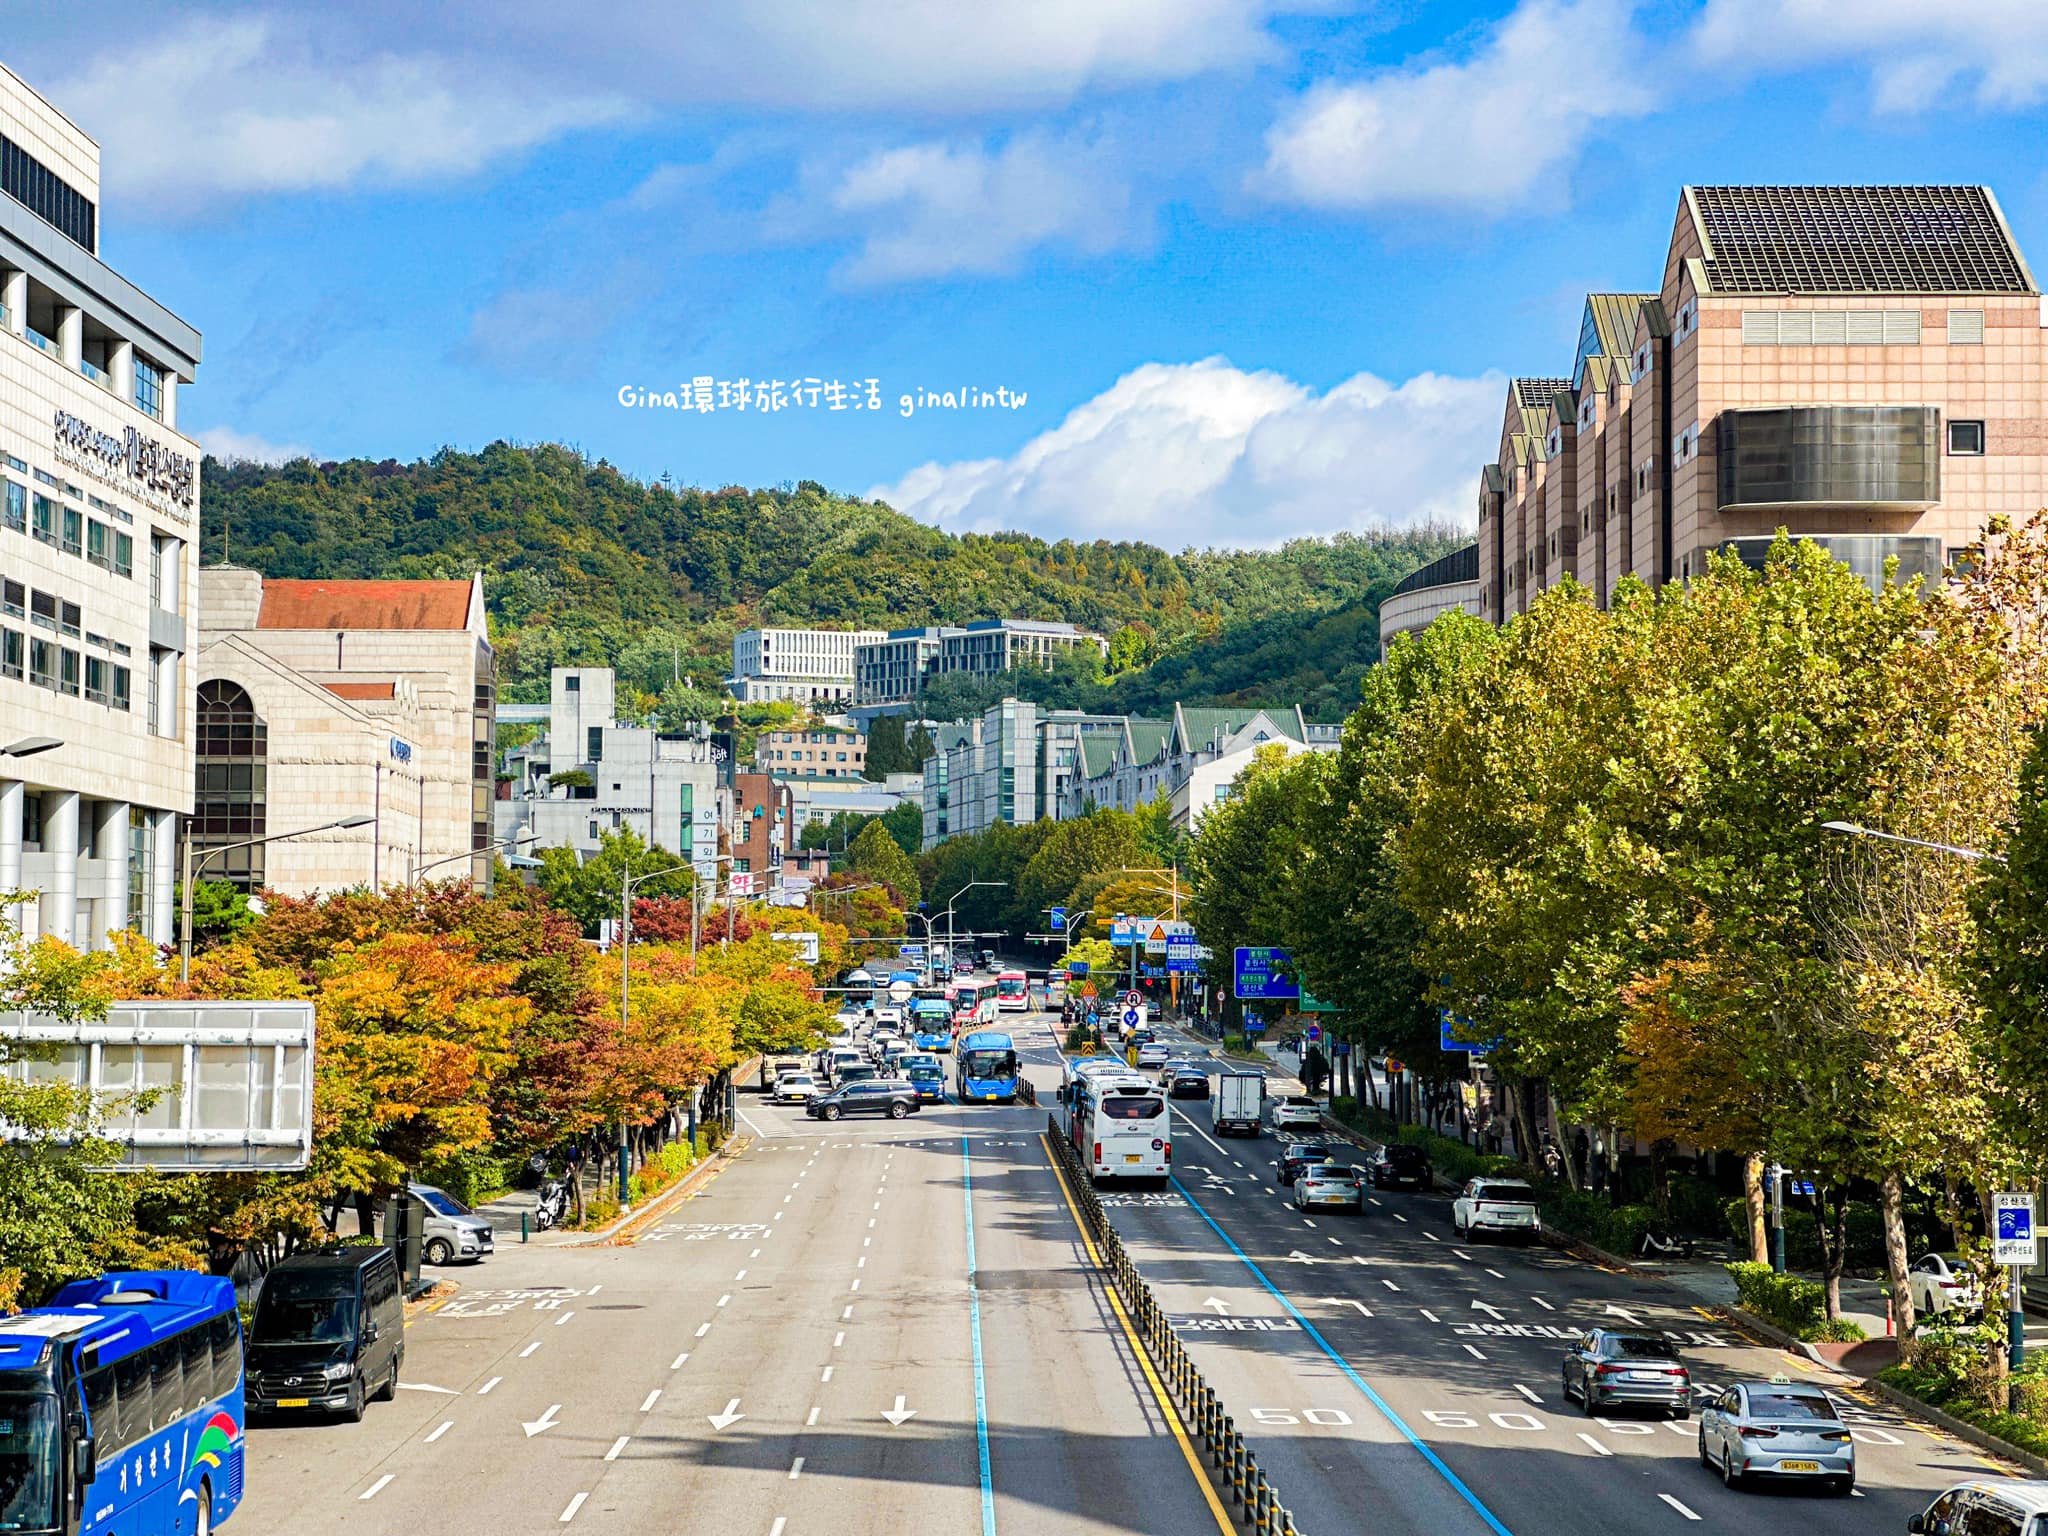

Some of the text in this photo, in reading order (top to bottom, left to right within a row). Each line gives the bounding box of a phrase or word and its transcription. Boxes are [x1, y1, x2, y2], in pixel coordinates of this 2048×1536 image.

[2000, 1197, 2029, 1206] 성산로
[1249, 1408, 1353, 1426] 50
[1420, 1410, 1547, 1431] 50
